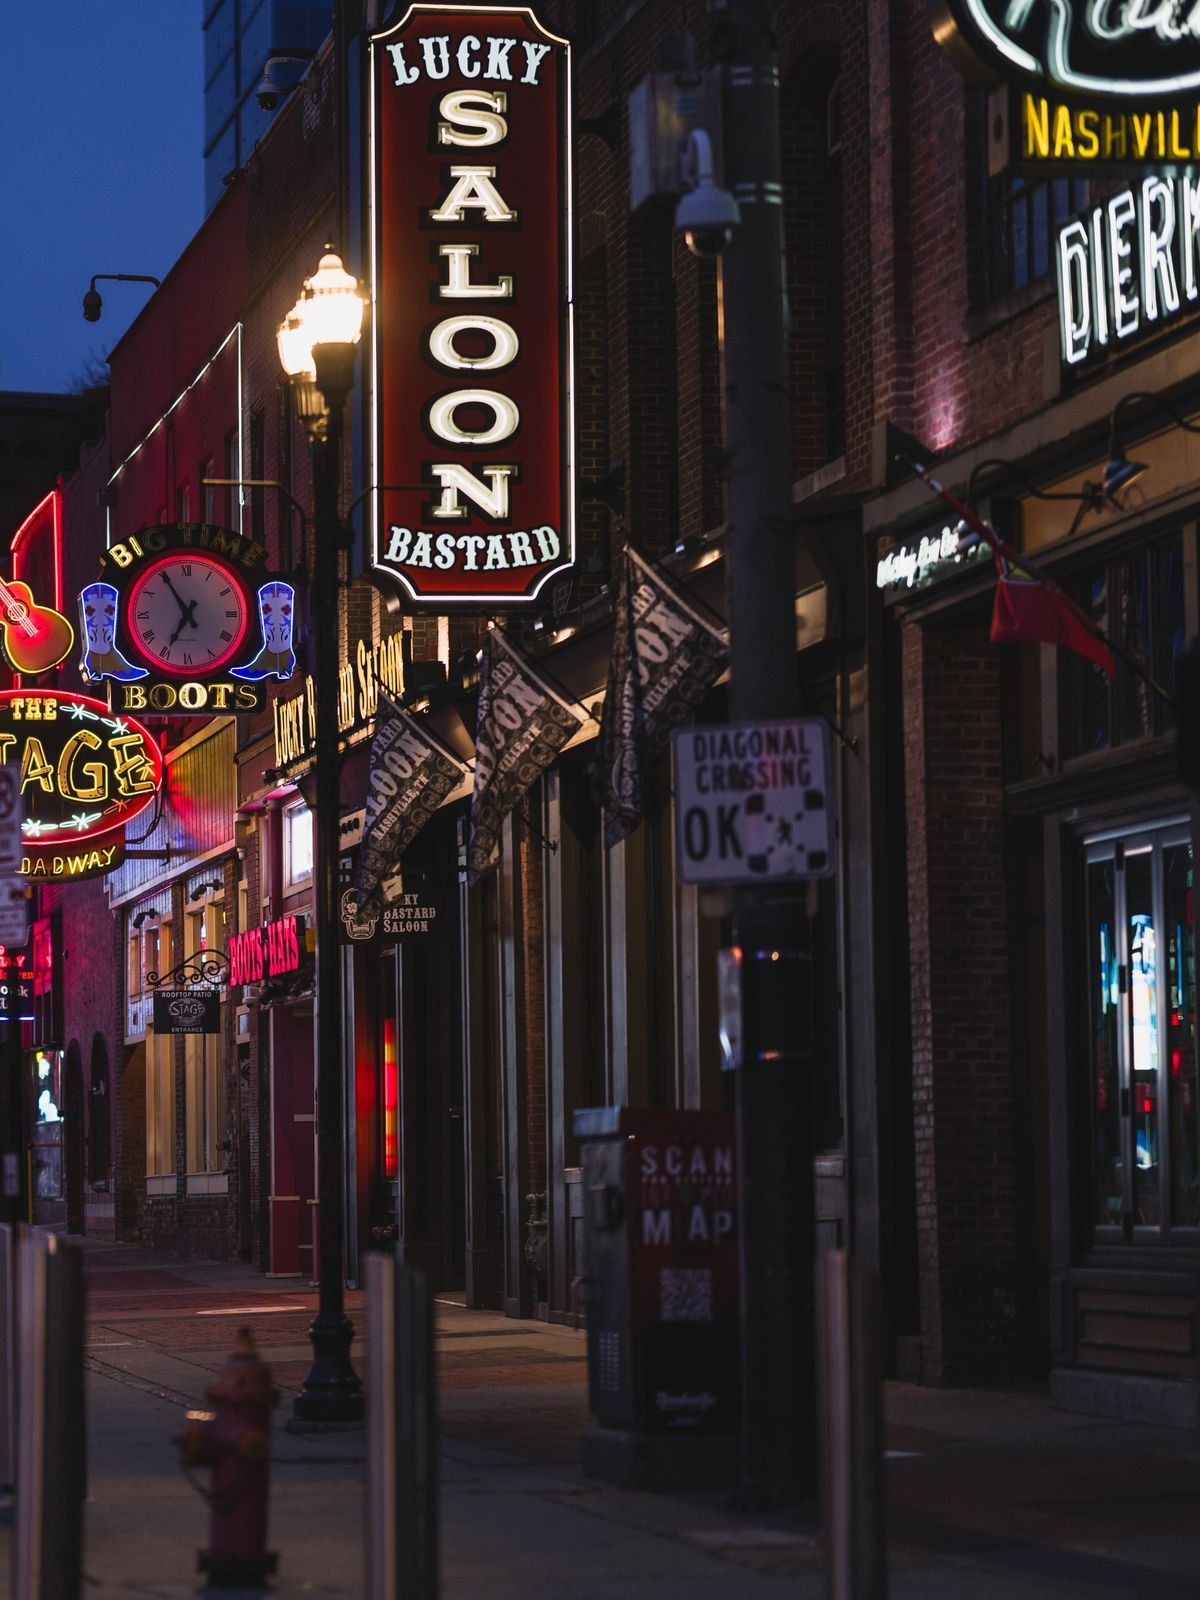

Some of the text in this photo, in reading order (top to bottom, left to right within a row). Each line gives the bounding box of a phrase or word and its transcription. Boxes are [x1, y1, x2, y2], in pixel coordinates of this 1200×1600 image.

[386, 35, 550, 86] LUCKY
[1024, 93, 1200, 159] NASHVIL
[429, 90, 520, 518] SALOON
[108, 521, 264, 568] BIG TIME
[384, 525, 560, 570] BASTARD
[10, 697, 57, 721] THE
[122, 683, 258, 711] BOOTS
[693, 728, 811, 762] DIAGONAL
[695, 759, 812, 794] CROSSING
[684, 805, 743, 862] OK
[383, 907, 437, 920] BASTARD
[383, 919, 429, 933] SALOON
[229, 914, 299, 987] BOOTS HATS
[169, 1001, 204, 1016] STAGE
[640, 1145, 733, 1175] SCAN
[641, 1204, 734, 1248] MAP
